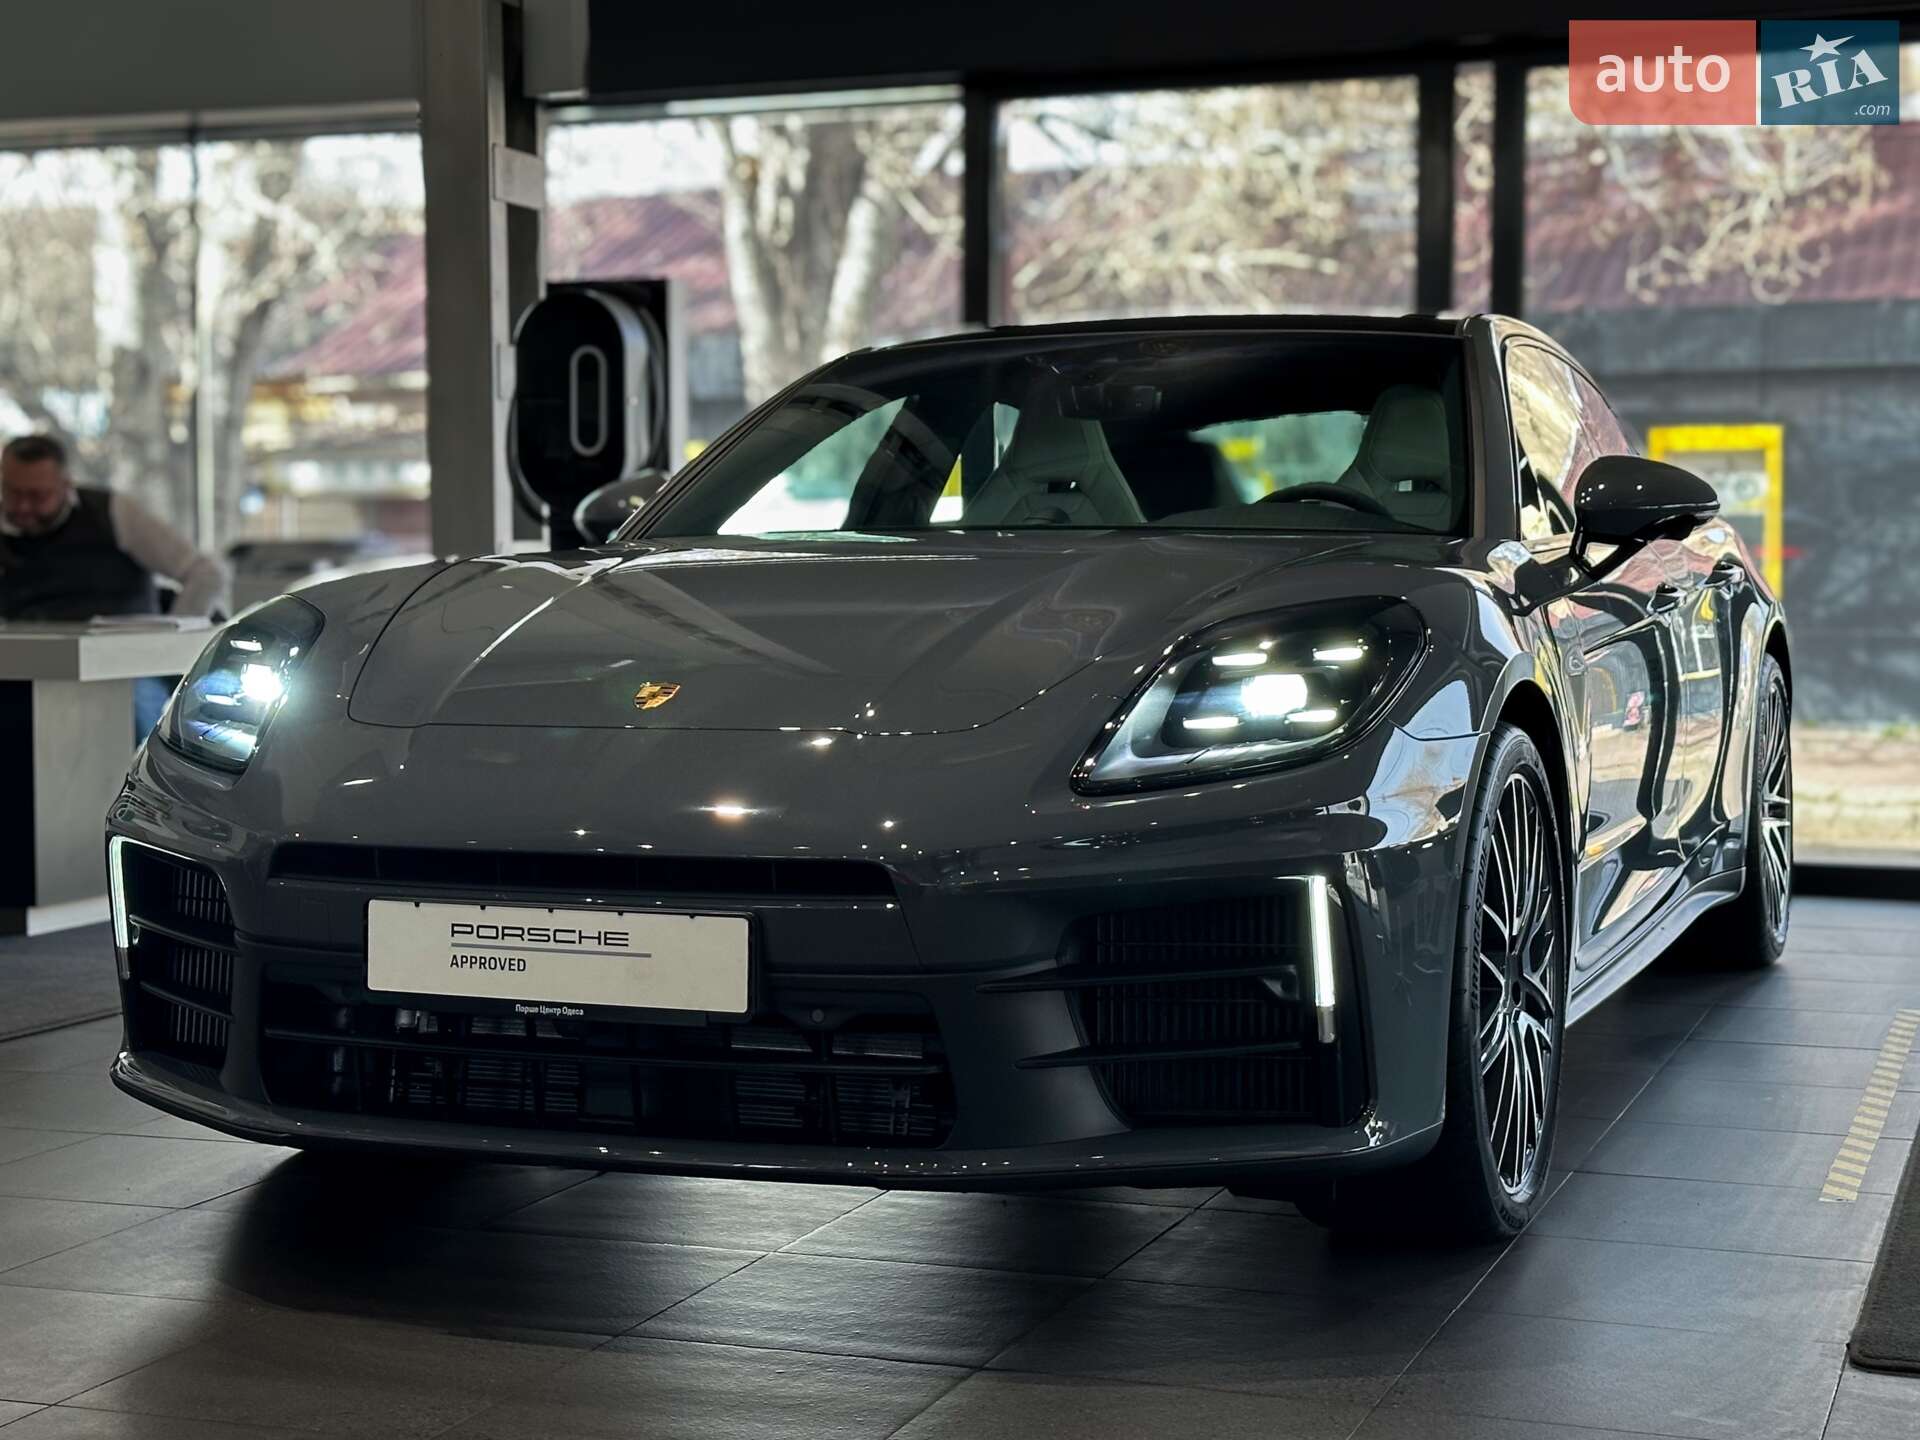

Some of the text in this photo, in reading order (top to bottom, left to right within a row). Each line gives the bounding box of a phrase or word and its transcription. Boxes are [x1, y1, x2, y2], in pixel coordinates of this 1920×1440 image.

[451, 923, 629, 946] PORSCHE
[450, 955, 526, 972] APPROVED
[540, 1005, 561, 1016] Центр
[562, 1006, 584, 1016] Одеса
